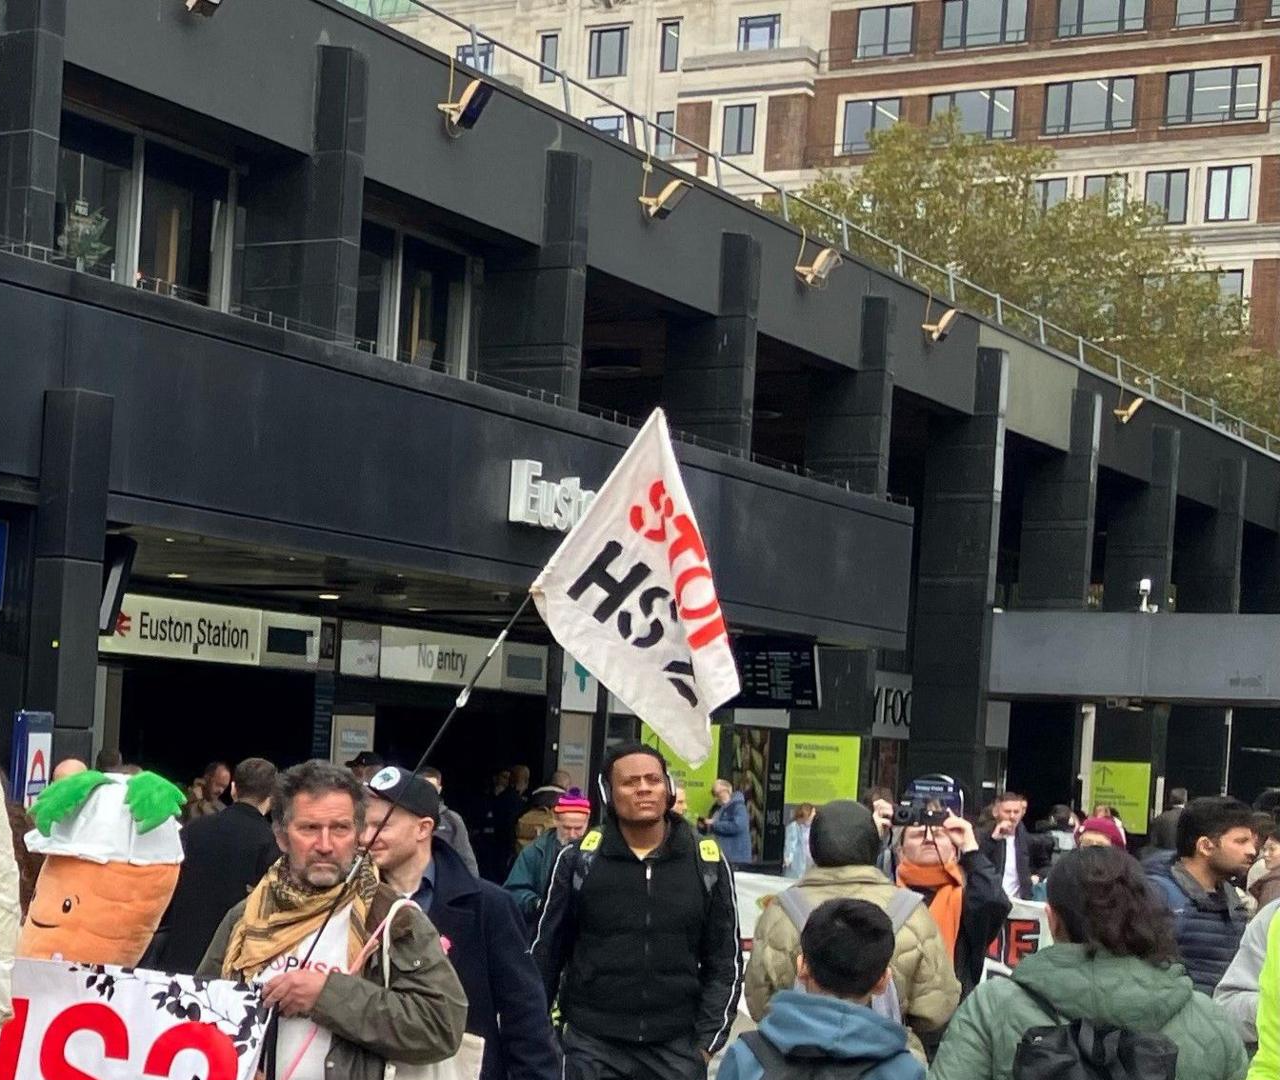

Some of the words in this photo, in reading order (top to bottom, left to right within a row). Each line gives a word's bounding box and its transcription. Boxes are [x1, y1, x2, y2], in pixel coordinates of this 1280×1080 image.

[139, 611, 193, 644] Euston
[196, 617, 250, 650] Station
[417, 642, 435, 669] No
[436, 648, 468, 679] entry
